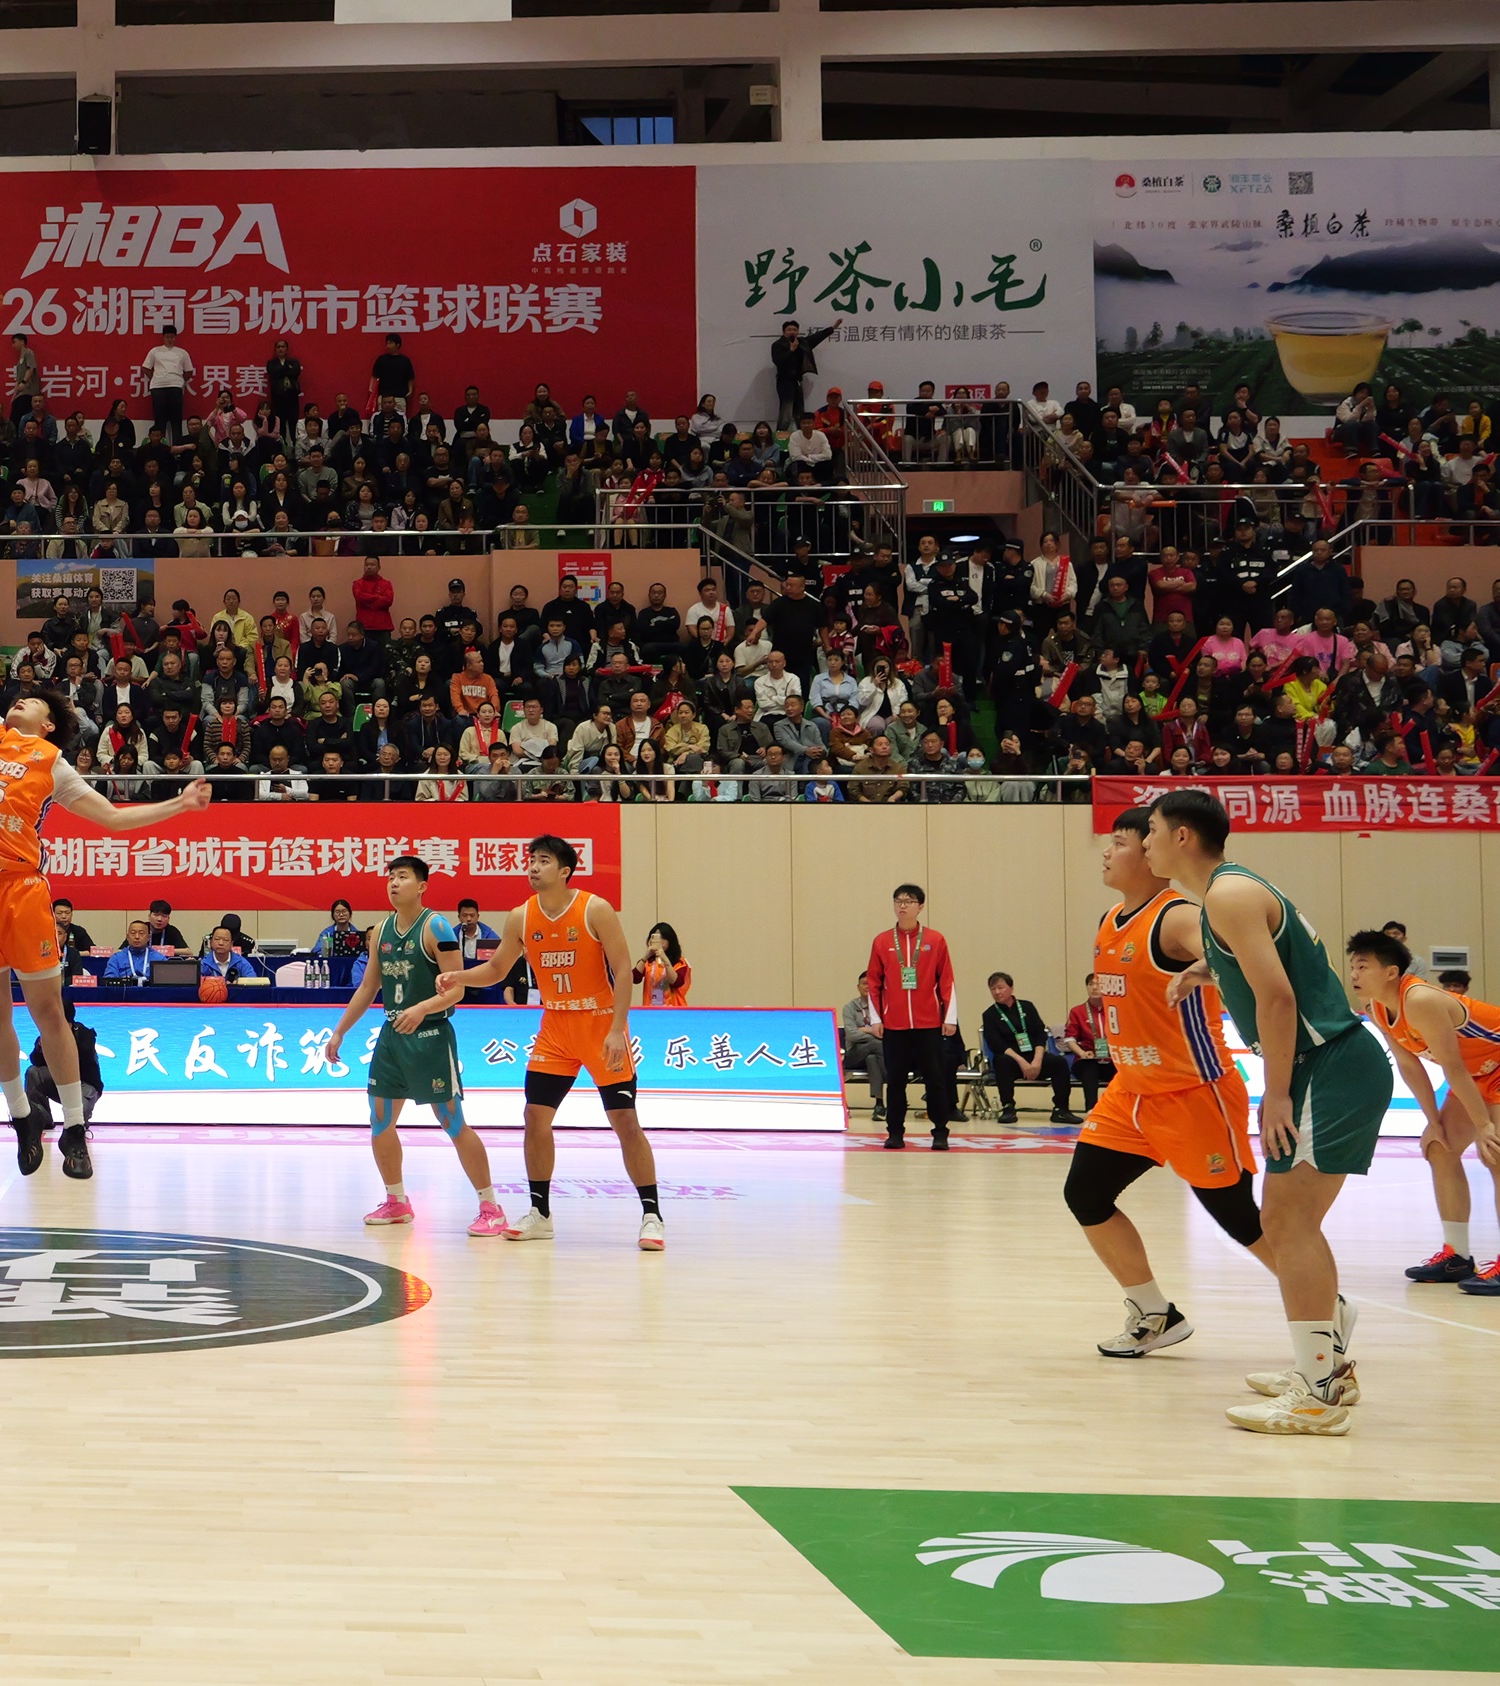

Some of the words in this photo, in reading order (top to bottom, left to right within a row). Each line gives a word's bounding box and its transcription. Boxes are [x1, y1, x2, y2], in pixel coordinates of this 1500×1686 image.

[20, 202, 291, 278] 湘BA
[532, 242, 628, 263] 点石家装
[744, 240, 1047, 315] 野茶小毛
[31, 573, 94, 584] 关注桑植体育
[1321, 782, 1500, 826] 血脉连桑
[539, 949, 577, 968] 邵阳
[552, 973, 573, 994] 71
[664, 1034, 828, 1070] 乐善人生
[1108, 1045, 1163, 1068] 石家装
